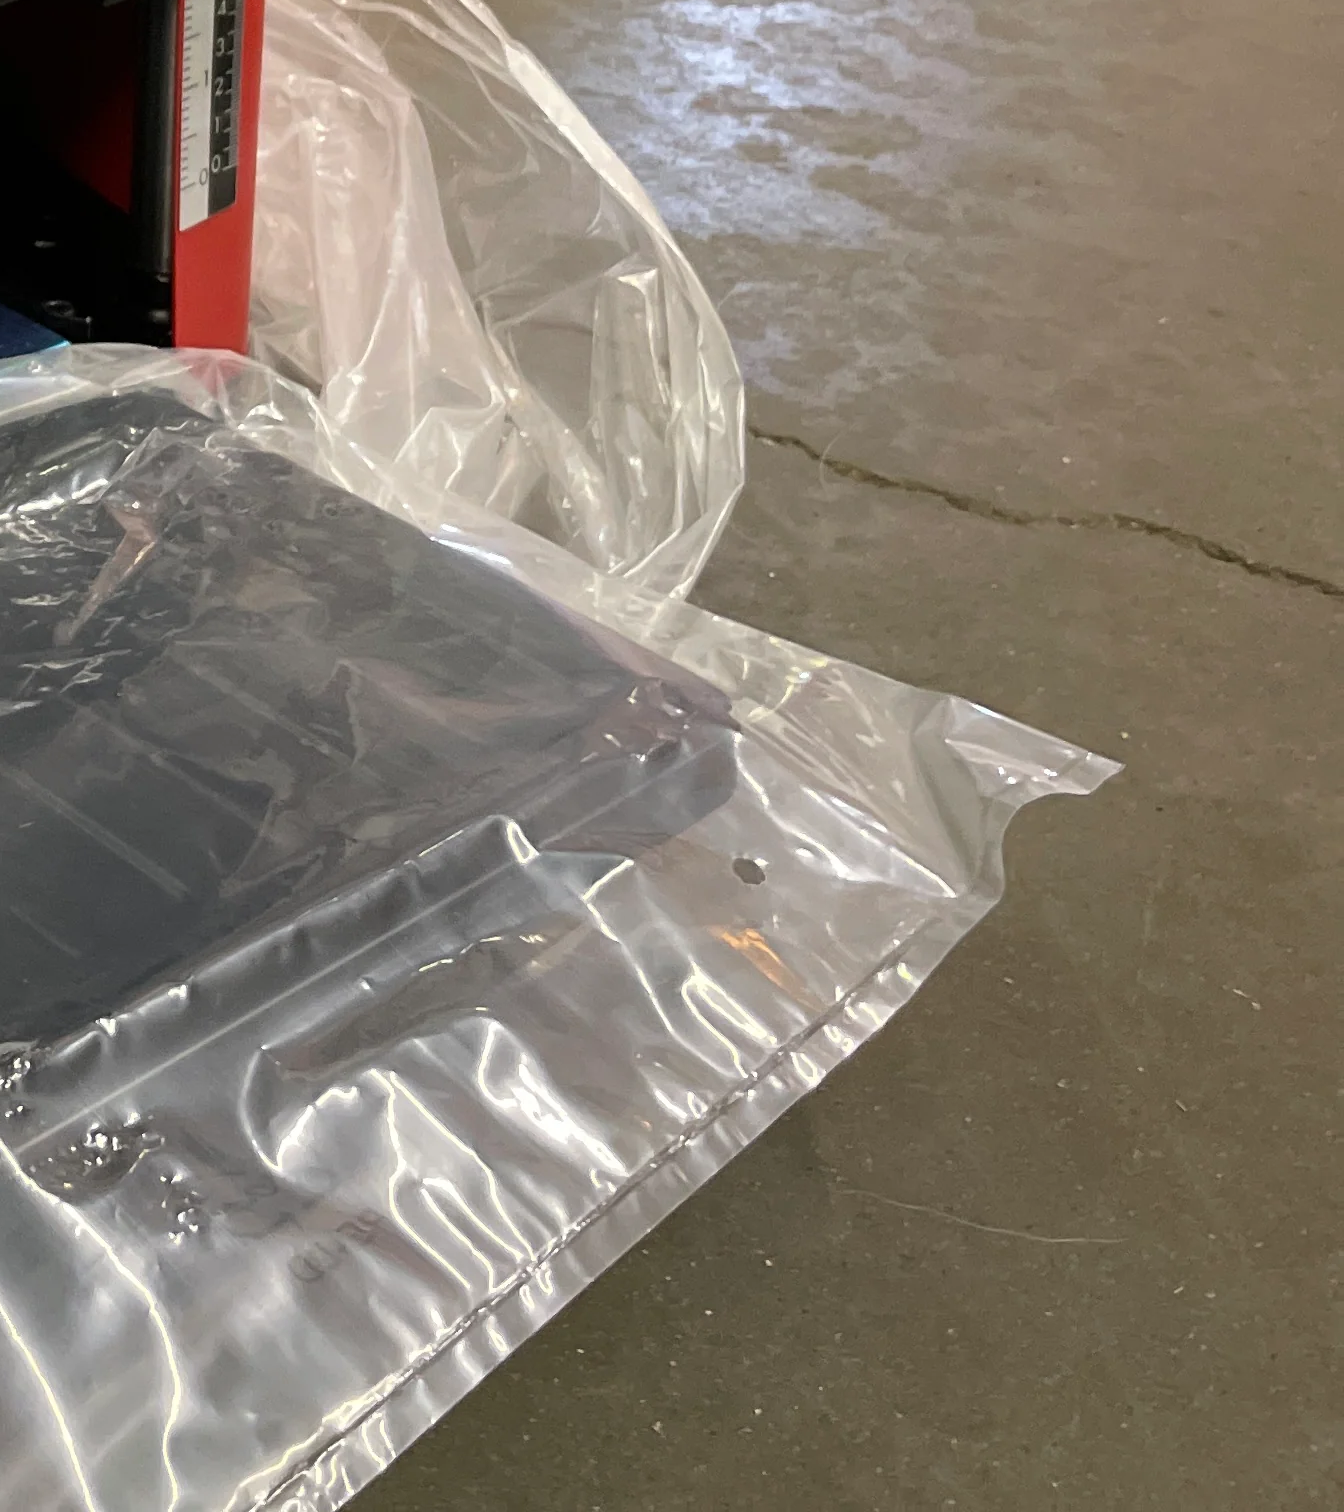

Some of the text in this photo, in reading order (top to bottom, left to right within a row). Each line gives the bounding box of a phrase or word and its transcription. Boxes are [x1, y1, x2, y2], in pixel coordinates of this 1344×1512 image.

[216, 37, 226, 58] 3
[214, 76, 225, 97] 2
[211, 154, 222, 173] 0
[198, 166, 209, 186] 0
